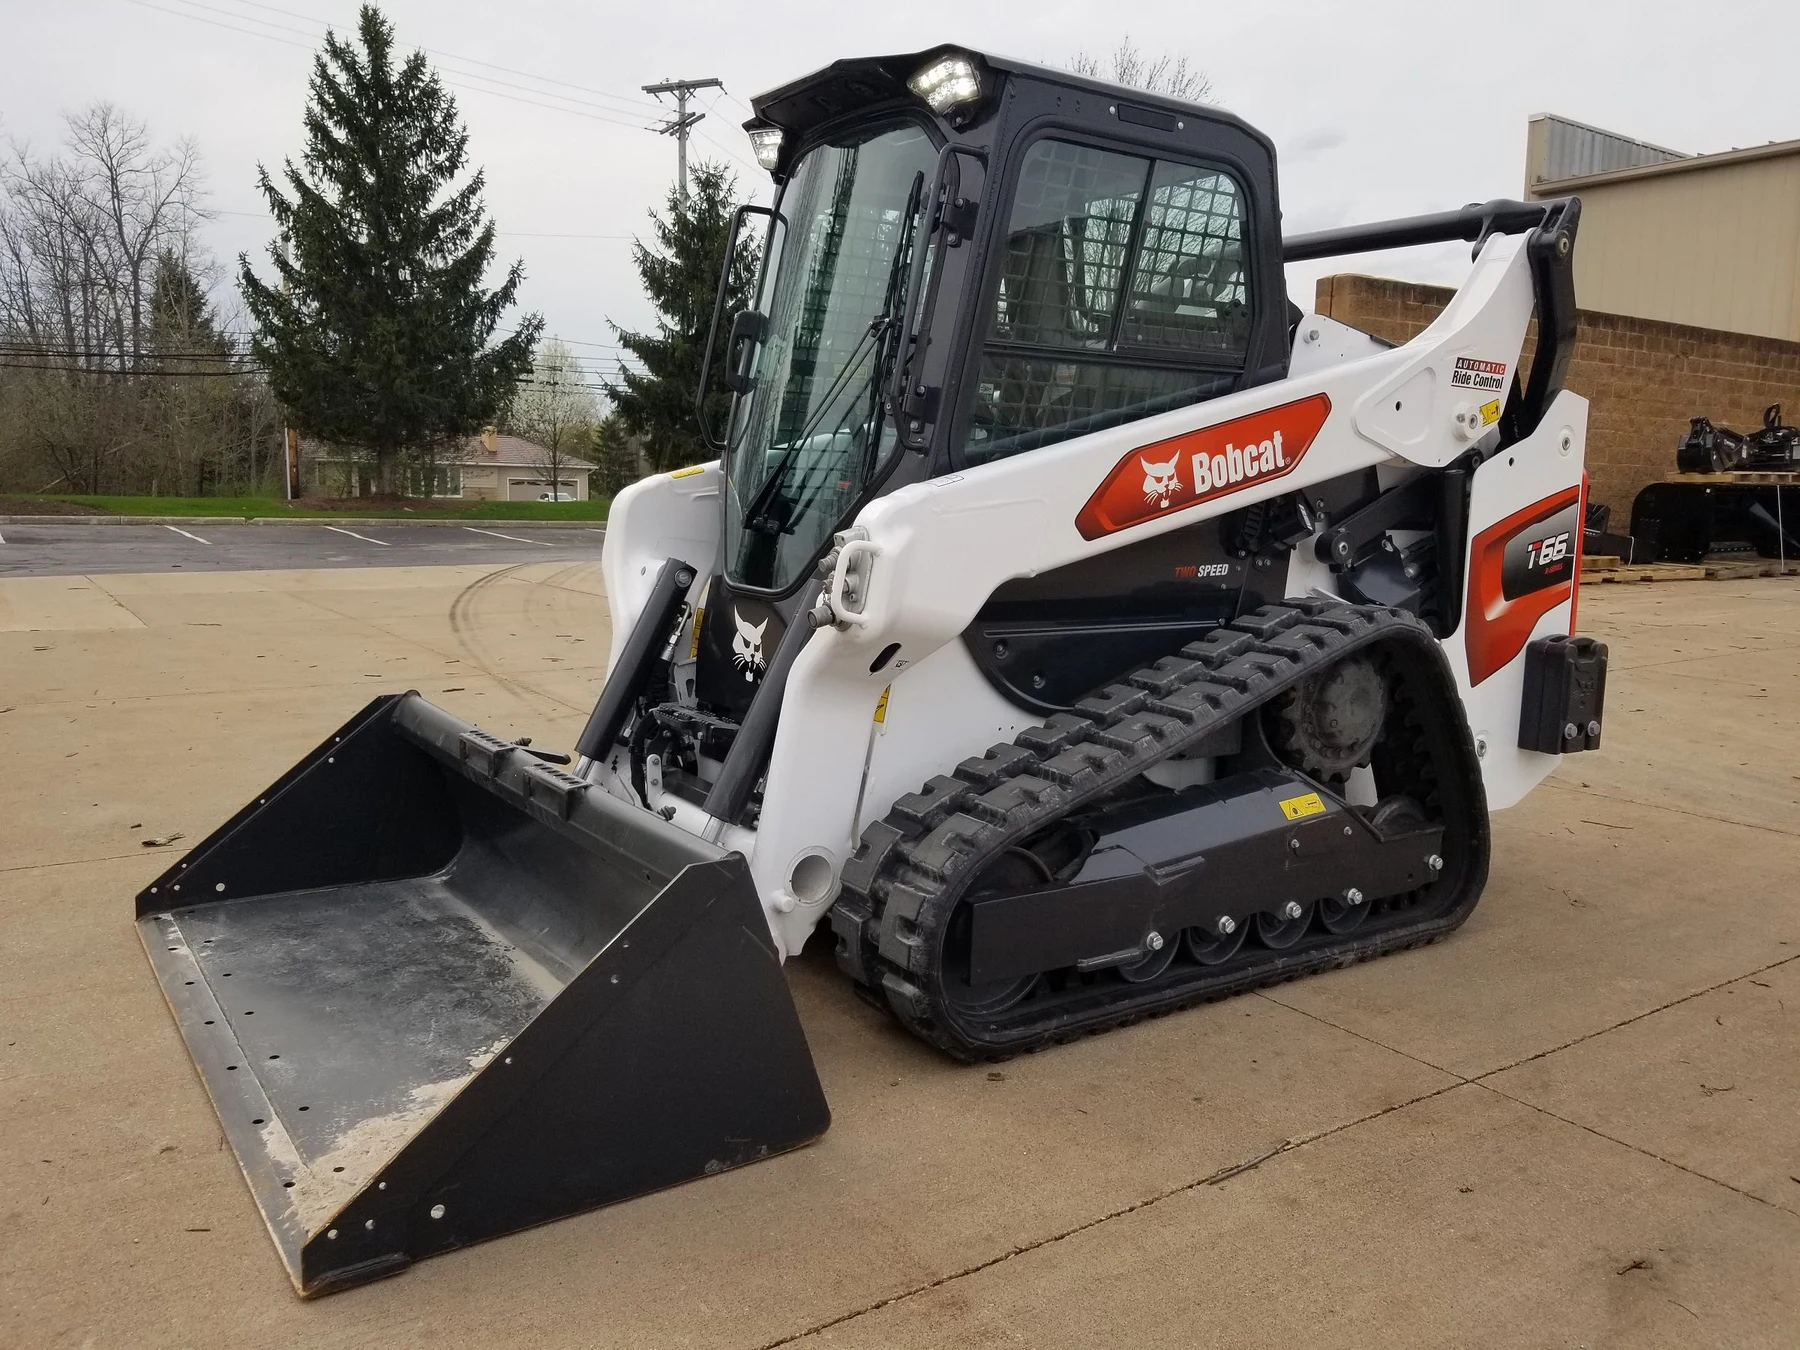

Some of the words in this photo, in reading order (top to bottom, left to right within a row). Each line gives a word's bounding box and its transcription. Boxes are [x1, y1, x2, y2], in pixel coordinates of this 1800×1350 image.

[1457, 359, 1504, 374] AUTOMATIC
[1452, 370, 1471, 386] Ride
[1473, 373, 1504, 389] Control
[1191, 430, 1285, 495] Bobcat
[1527, 531, 1569, 569] T66
[1175, 565, 1197, 578] TWO
[1198, 563, 1229, 577] SPEED
